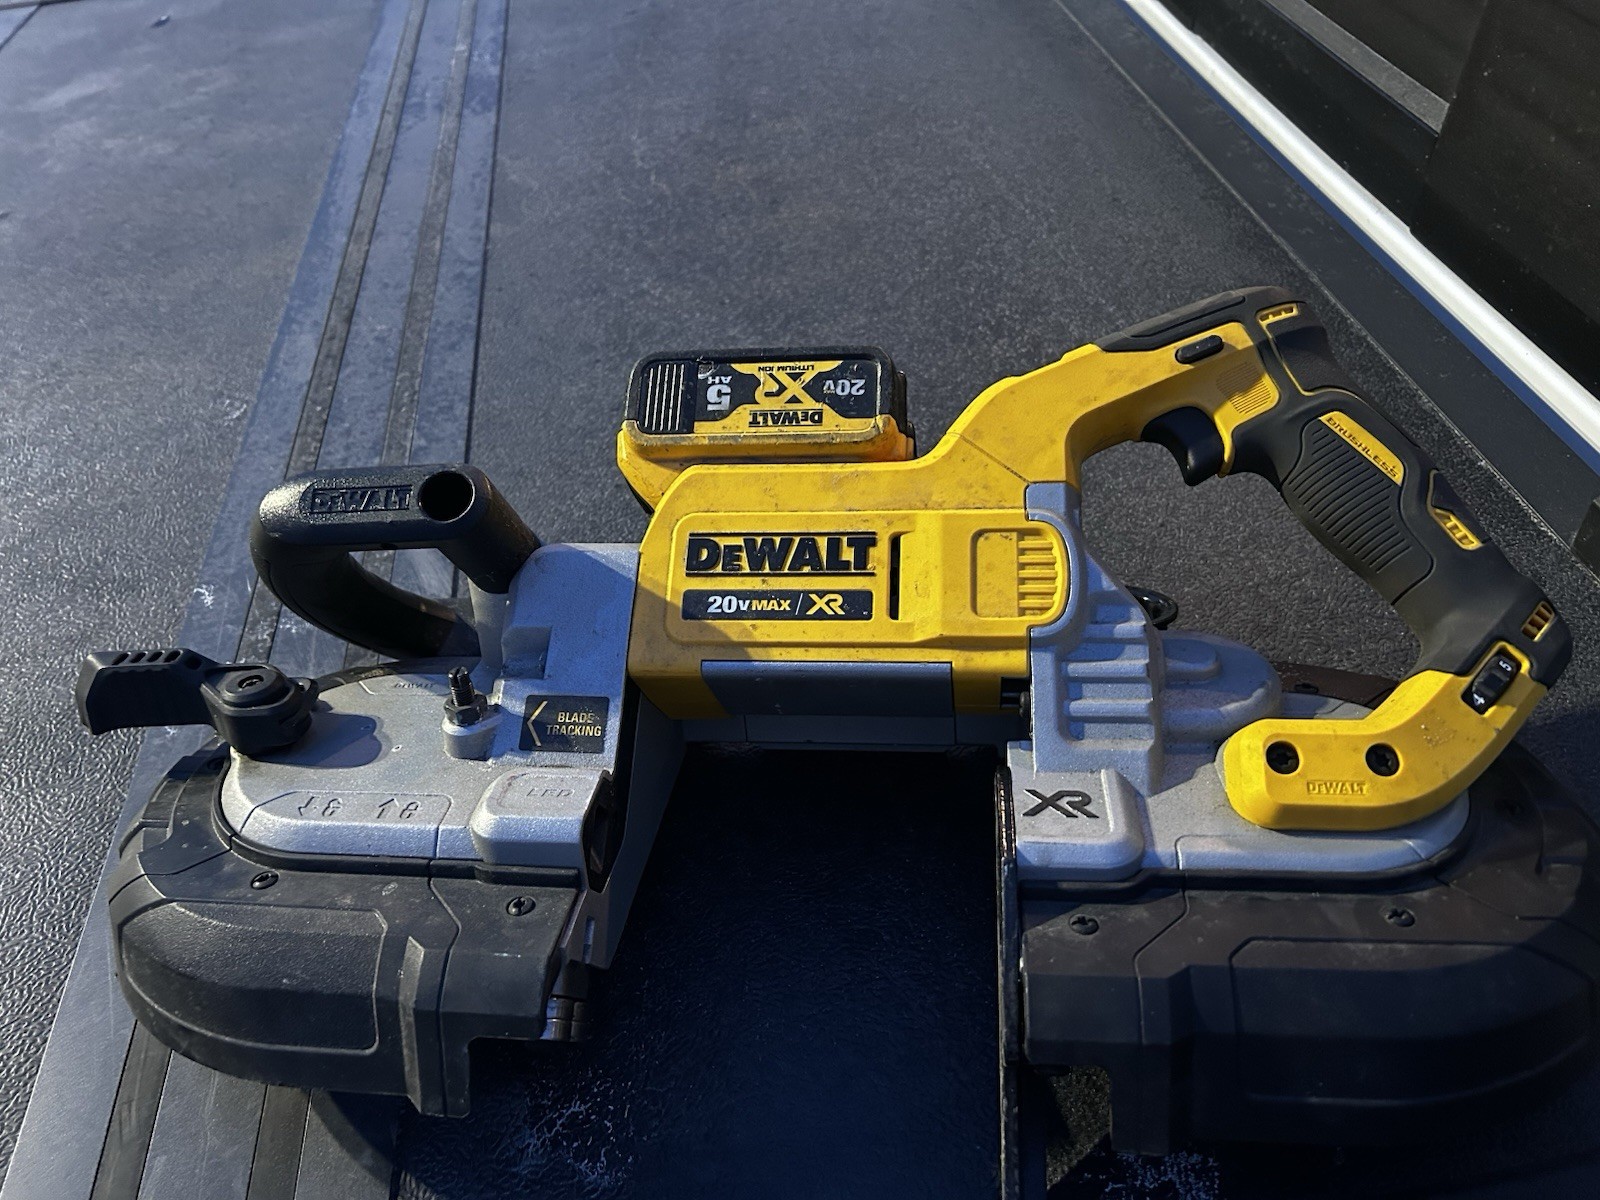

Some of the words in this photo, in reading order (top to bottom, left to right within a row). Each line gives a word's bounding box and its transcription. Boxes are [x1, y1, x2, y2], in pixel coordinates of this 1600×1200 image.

[777, 364, 815, 372] LITHIUM
[823, 379, 866, 395] 20V
[706, 383, 732, 411] 5
[1326, 417, 1398, 478] BRUSHLESS
[805, 593, 846, 615] XR
[1499, 660, 1512, 672] 5
[1473, 693, 1485, 706] 4
[557, 711, 596, 723] BLADE
[546, 724, 602, 737] TRACKING
[1021, 789, 1100, 818] XR
